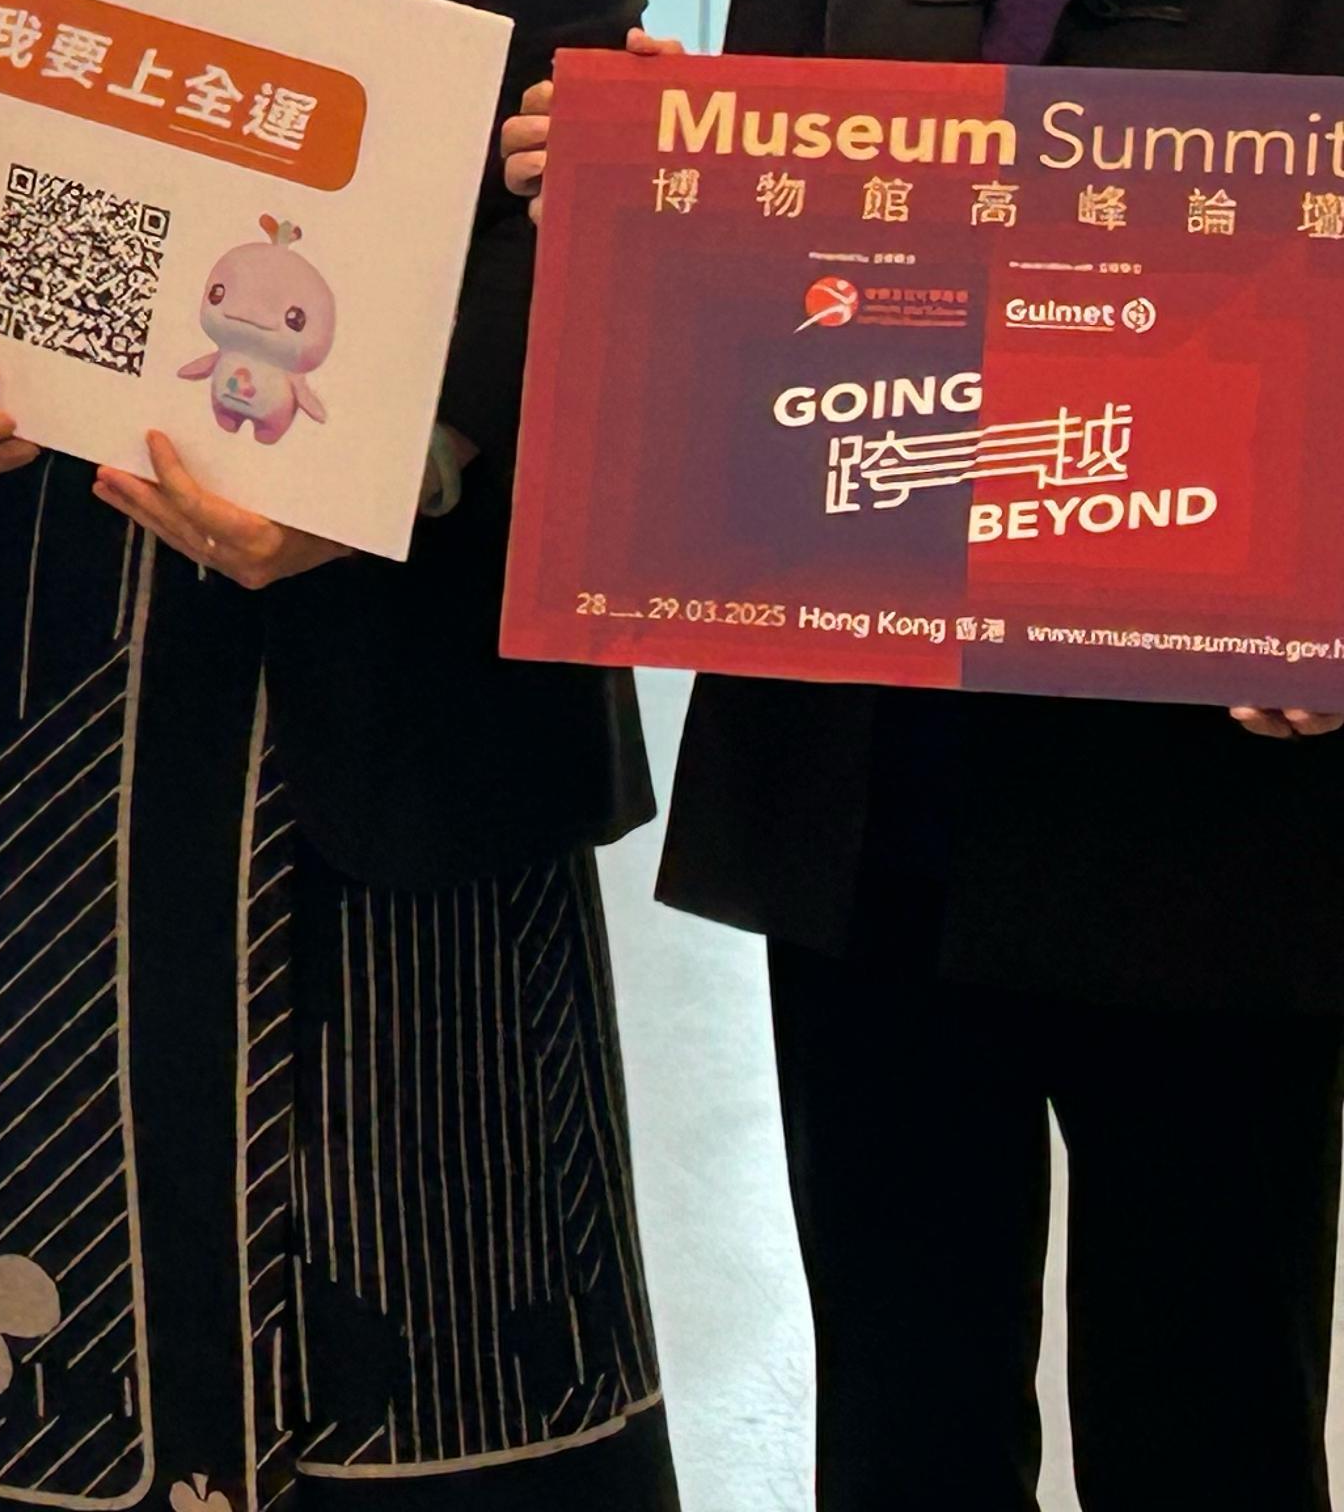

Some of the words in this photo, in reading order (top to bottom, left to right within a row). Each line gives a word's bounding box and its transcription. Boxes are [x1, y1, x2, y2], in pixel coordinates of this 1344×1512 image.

[657, 88, 1017, 166] Museum
[1039, 101, 1344, 178] Summit
[773, 372, 983, 427] GOING
[825, 402, 1133, 514] 跨越
[968, 486, 1218, 543] BEYOND
[798, 606, 870, 638] Hong
[877, 611, 946, 644] Kong
